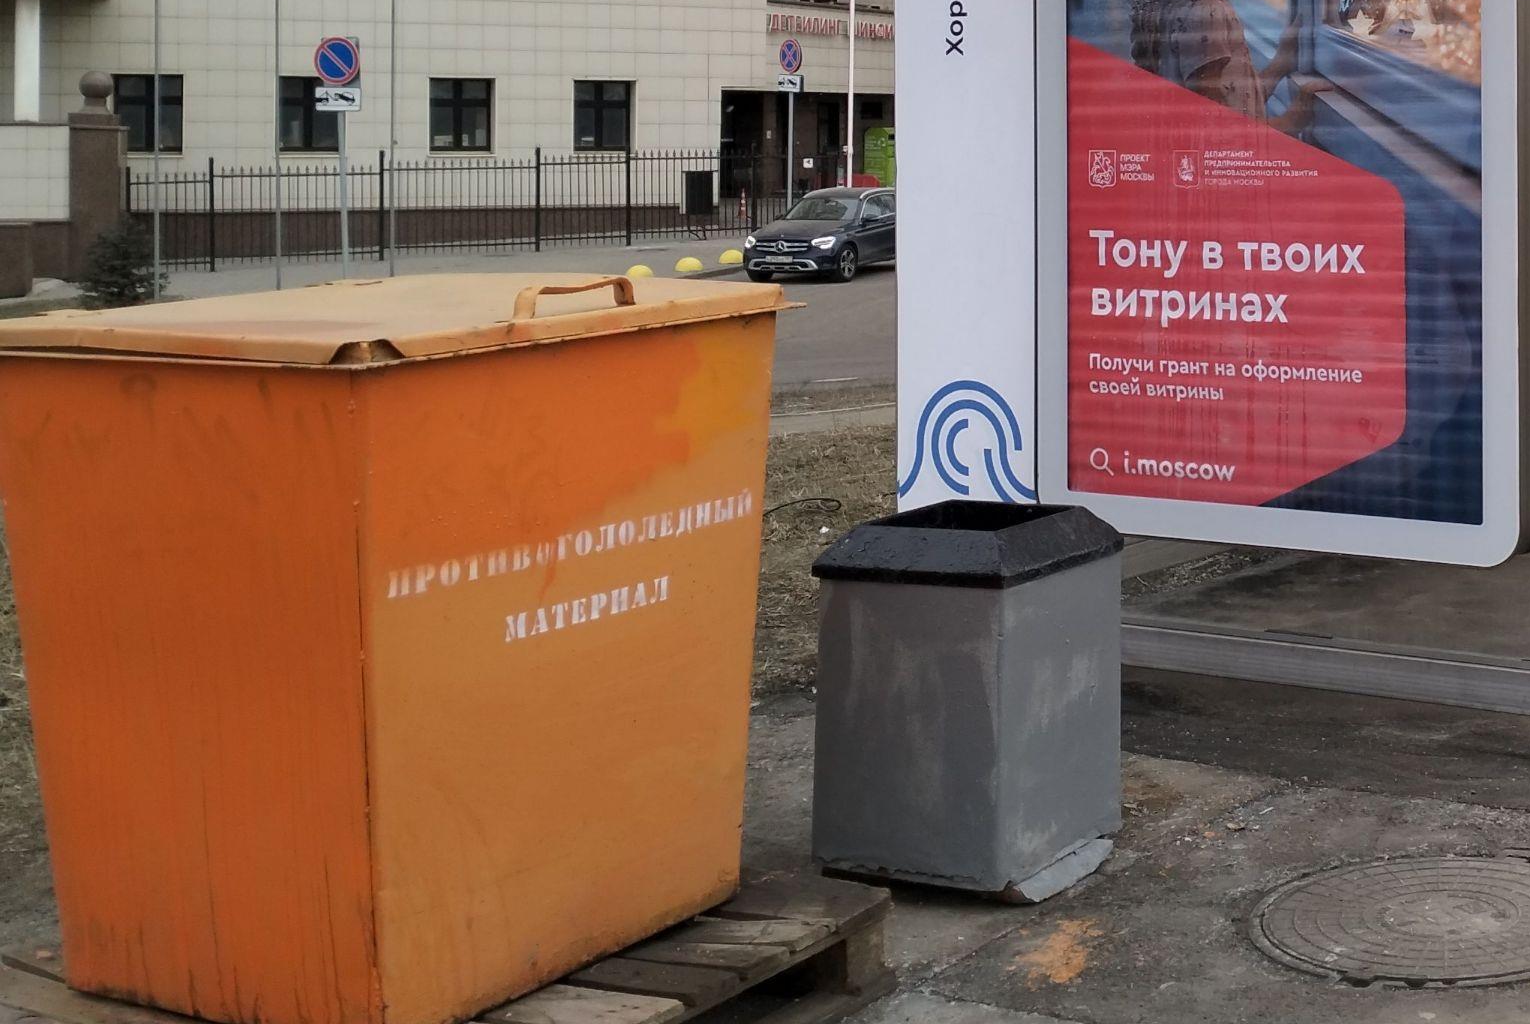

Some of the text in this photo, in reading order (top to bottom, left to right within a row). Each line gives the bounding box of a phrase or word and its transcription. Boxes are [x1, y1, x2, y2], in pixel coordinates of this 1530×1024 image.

[1120, 153, 1151, 162] ПРОЕКТ
[1204, 151, 1254, 159] ДЕПАРТАМЕНТ
[1204, 160, 1291, 168] ПРЕДПРИНИМАТЕЛЬСТВА
[1120, 163, 1142, 172] МЭРА
[1120, 173, 1155, 181] МОСКВЫ
[1211, 169, 1280, 177] ИННОВАЦИОННОГО
[1089, 229, 1366, 278] Тону в твоих
[1091, 287, 1289, 328] витринах
[1089, 353, 1363, 384] Получи грант на оформление
[1089, 377, 1224, 401] своей витрины
[1123, 451, 1236, 481] i.moscow
[387, 488, 752, 599] ПРОТИВОГОЛОЛЕДНЫЙ
[504, 575, 670, 643] МАТЕРИАЛ
